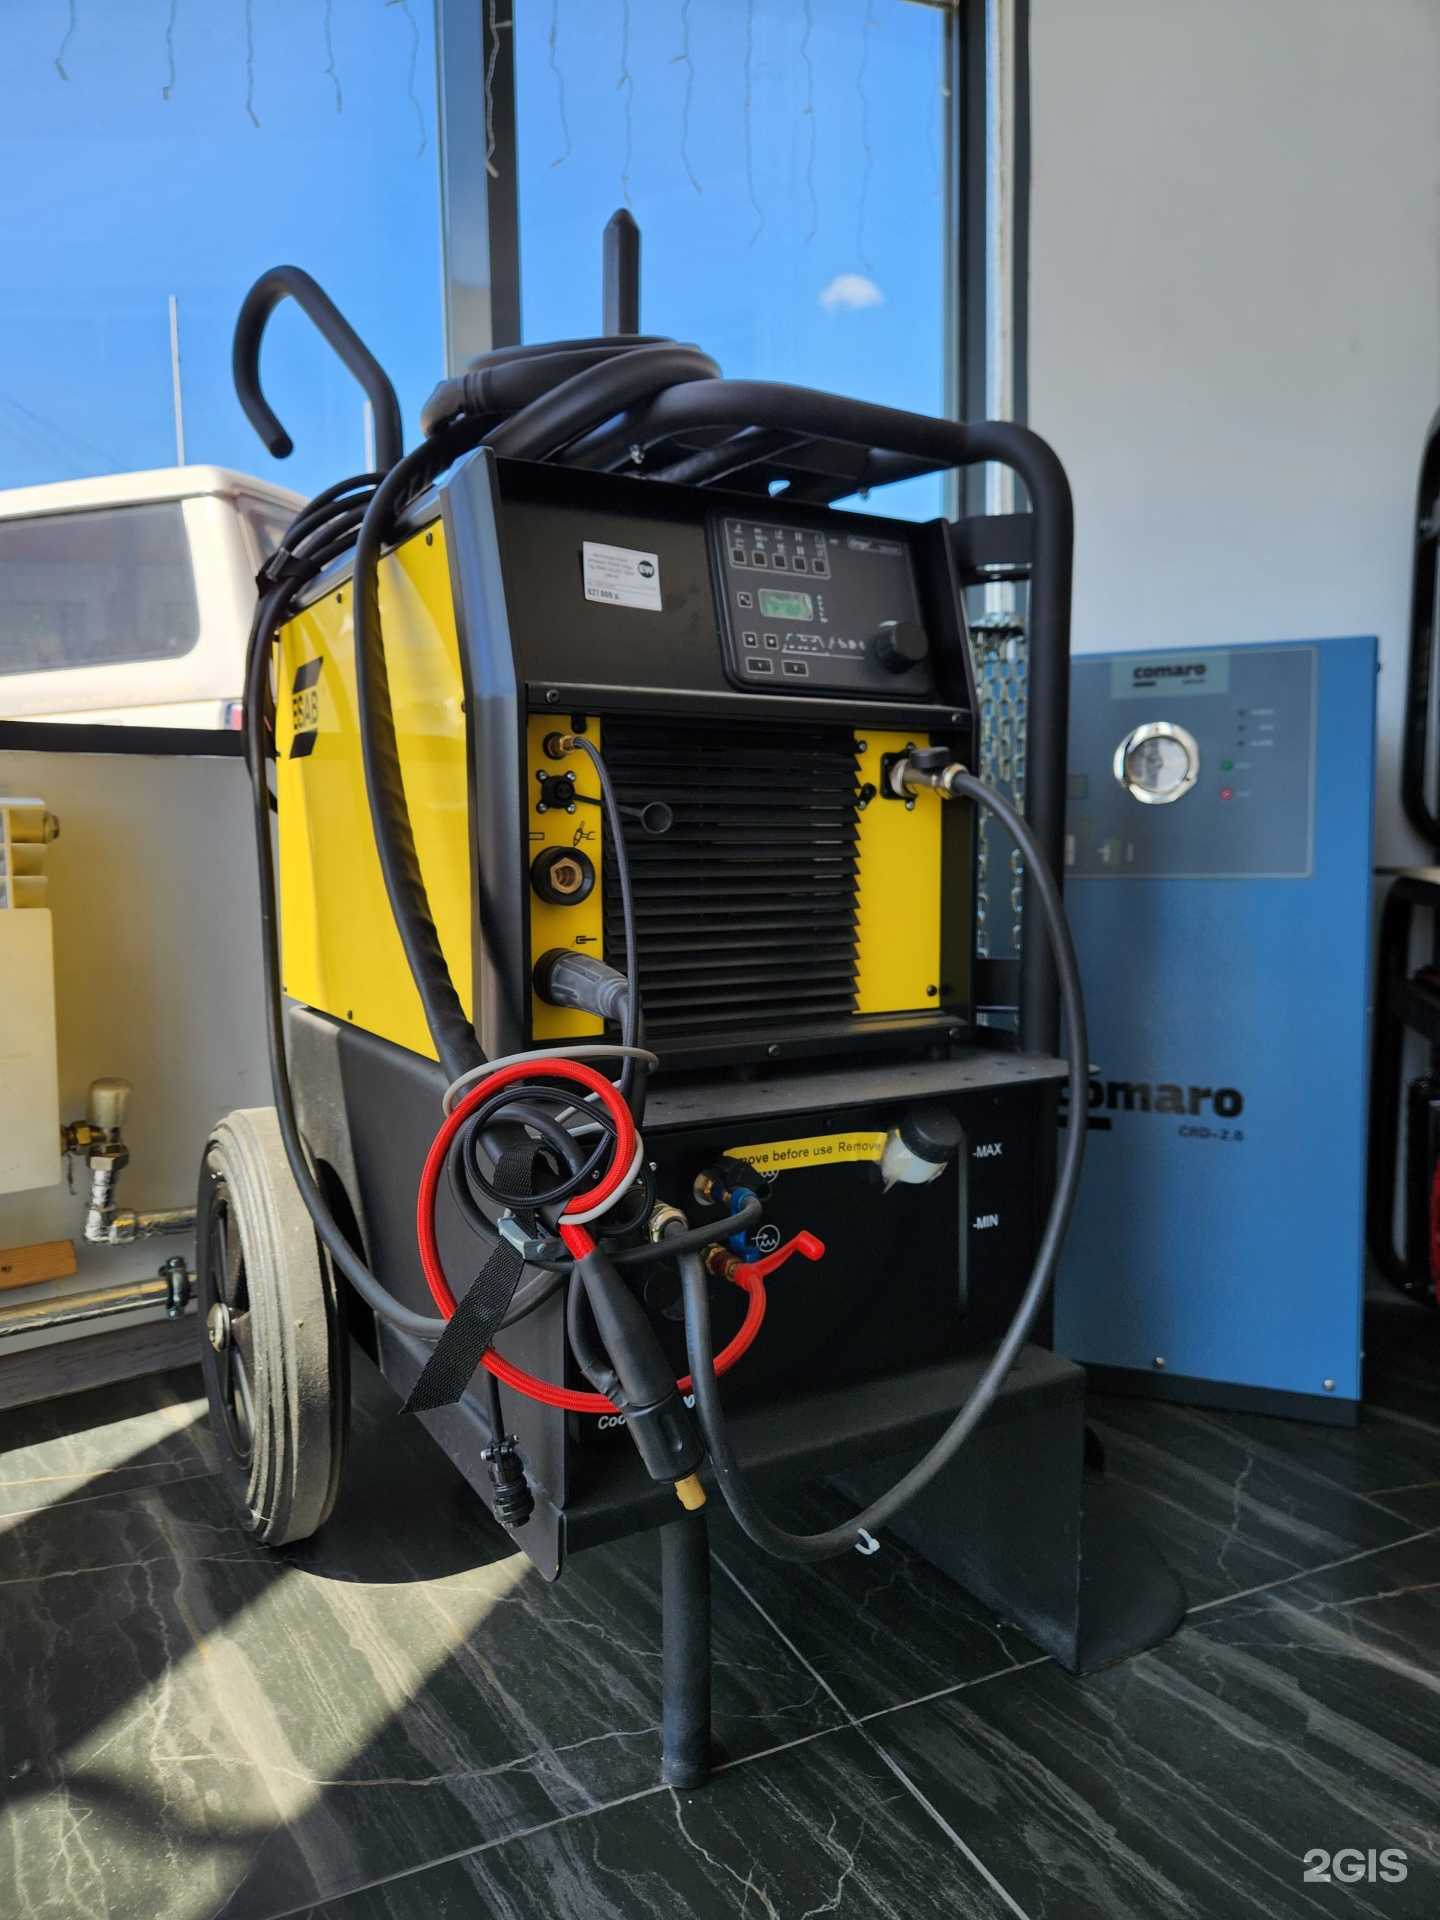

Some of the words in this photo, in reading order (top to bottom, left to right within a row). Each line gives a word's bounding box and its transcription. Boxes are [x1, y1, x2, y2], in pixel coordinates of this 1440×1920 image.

[1133, 663, 1207, 680] comaro
[292, 690, 319, 730] ESAB
[772, 1147, 810, 1162] before
[813, 1145, 833, 1156] use
